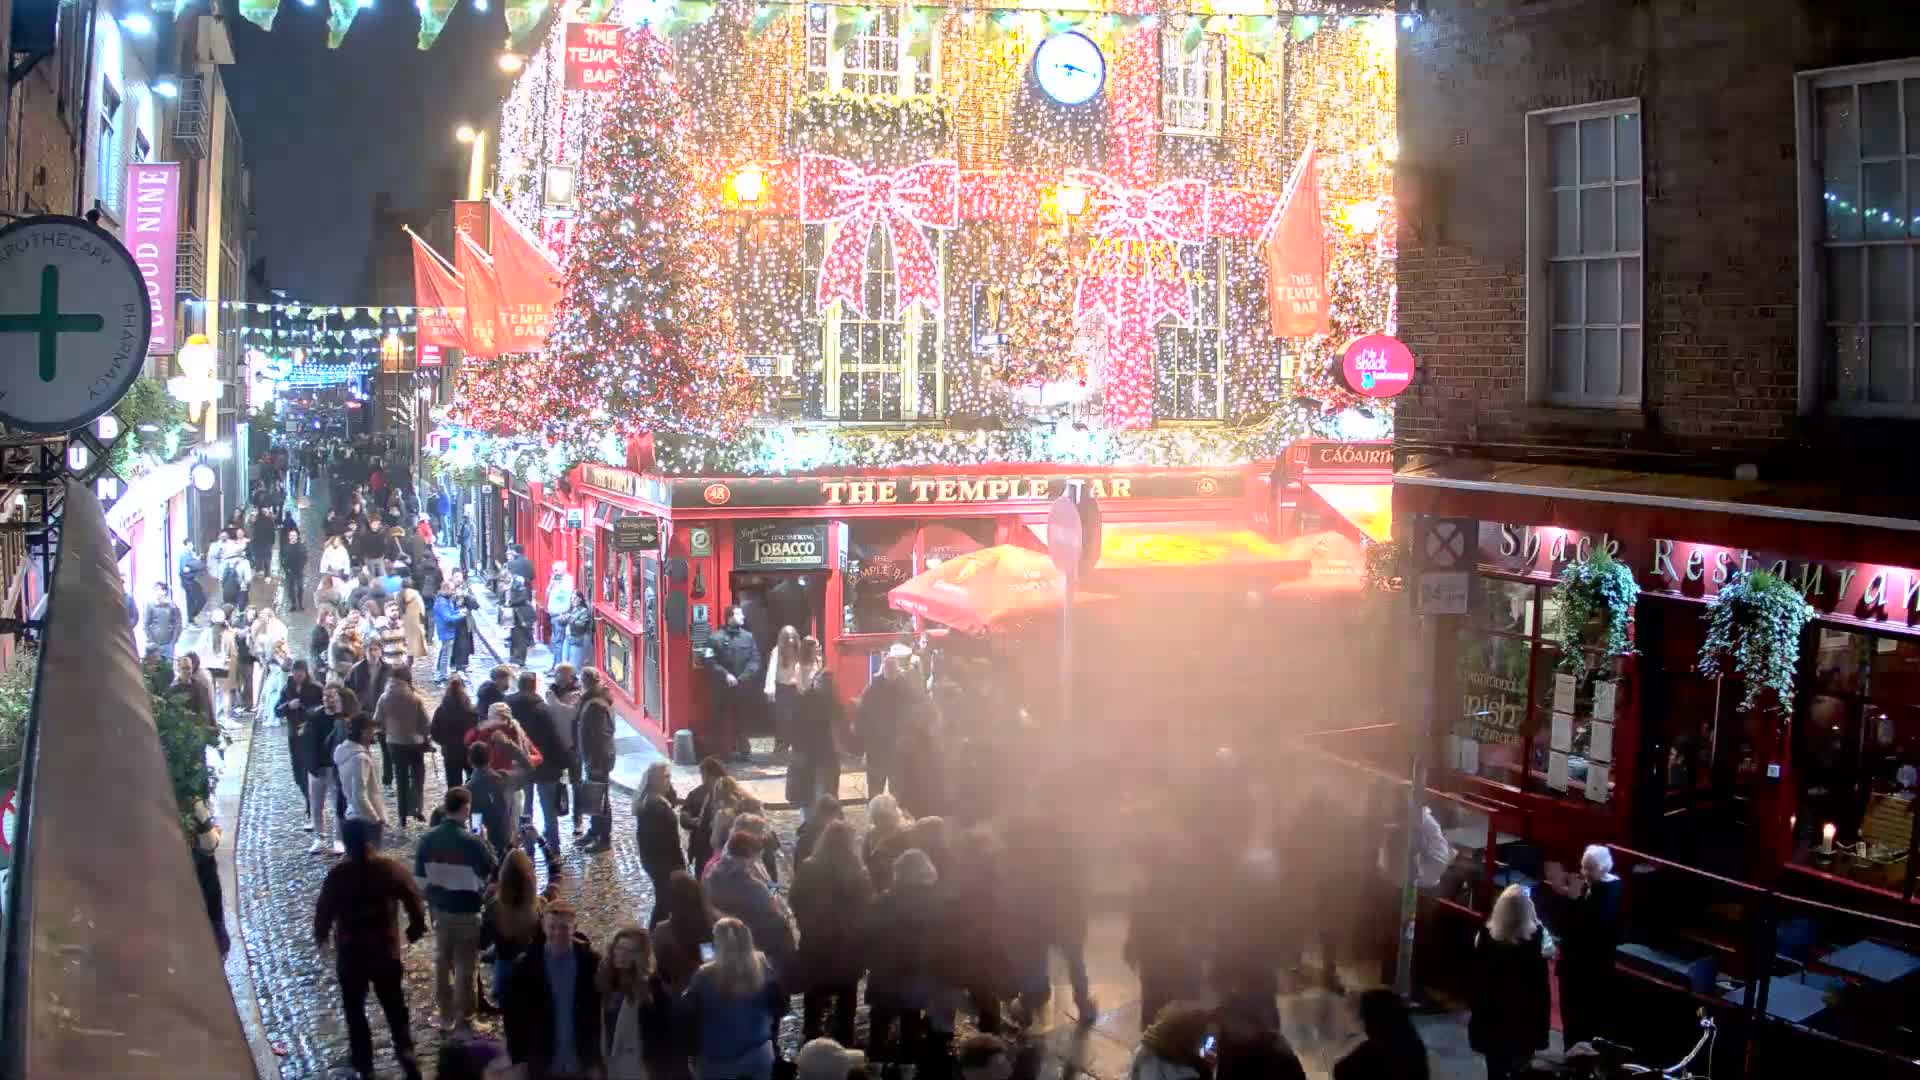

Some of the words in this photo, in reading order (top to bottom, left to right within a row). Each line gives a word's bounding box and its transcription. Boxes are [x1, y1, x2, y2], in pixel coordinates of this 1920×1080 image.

[583, 28, 617, 46] THE
[567, 47, 623, 66] TEMPL
[136, 171, 169, 232] NINE
[1290, 273, 1313, 285] THE
[1276, 286, 1321, 300] TEMPL
[518, 304, 544, 313] THE
[1292, 302, 1317, 312] BAR
[499, 312, 553, 326] TEMPL
[514, 326, 546, 336] BAR
[88, 303, 137, 400] PHARMACY
[710, 487, 725, 499] 48
[822, 481, 898, 504] THE
[911, 479, 1049, 502] TEMPLE
[1066, 479, 1132, 498] AR
[750, 538, 815, 561] TOBACCO
[1500, 523, 1619, 566] Shack
